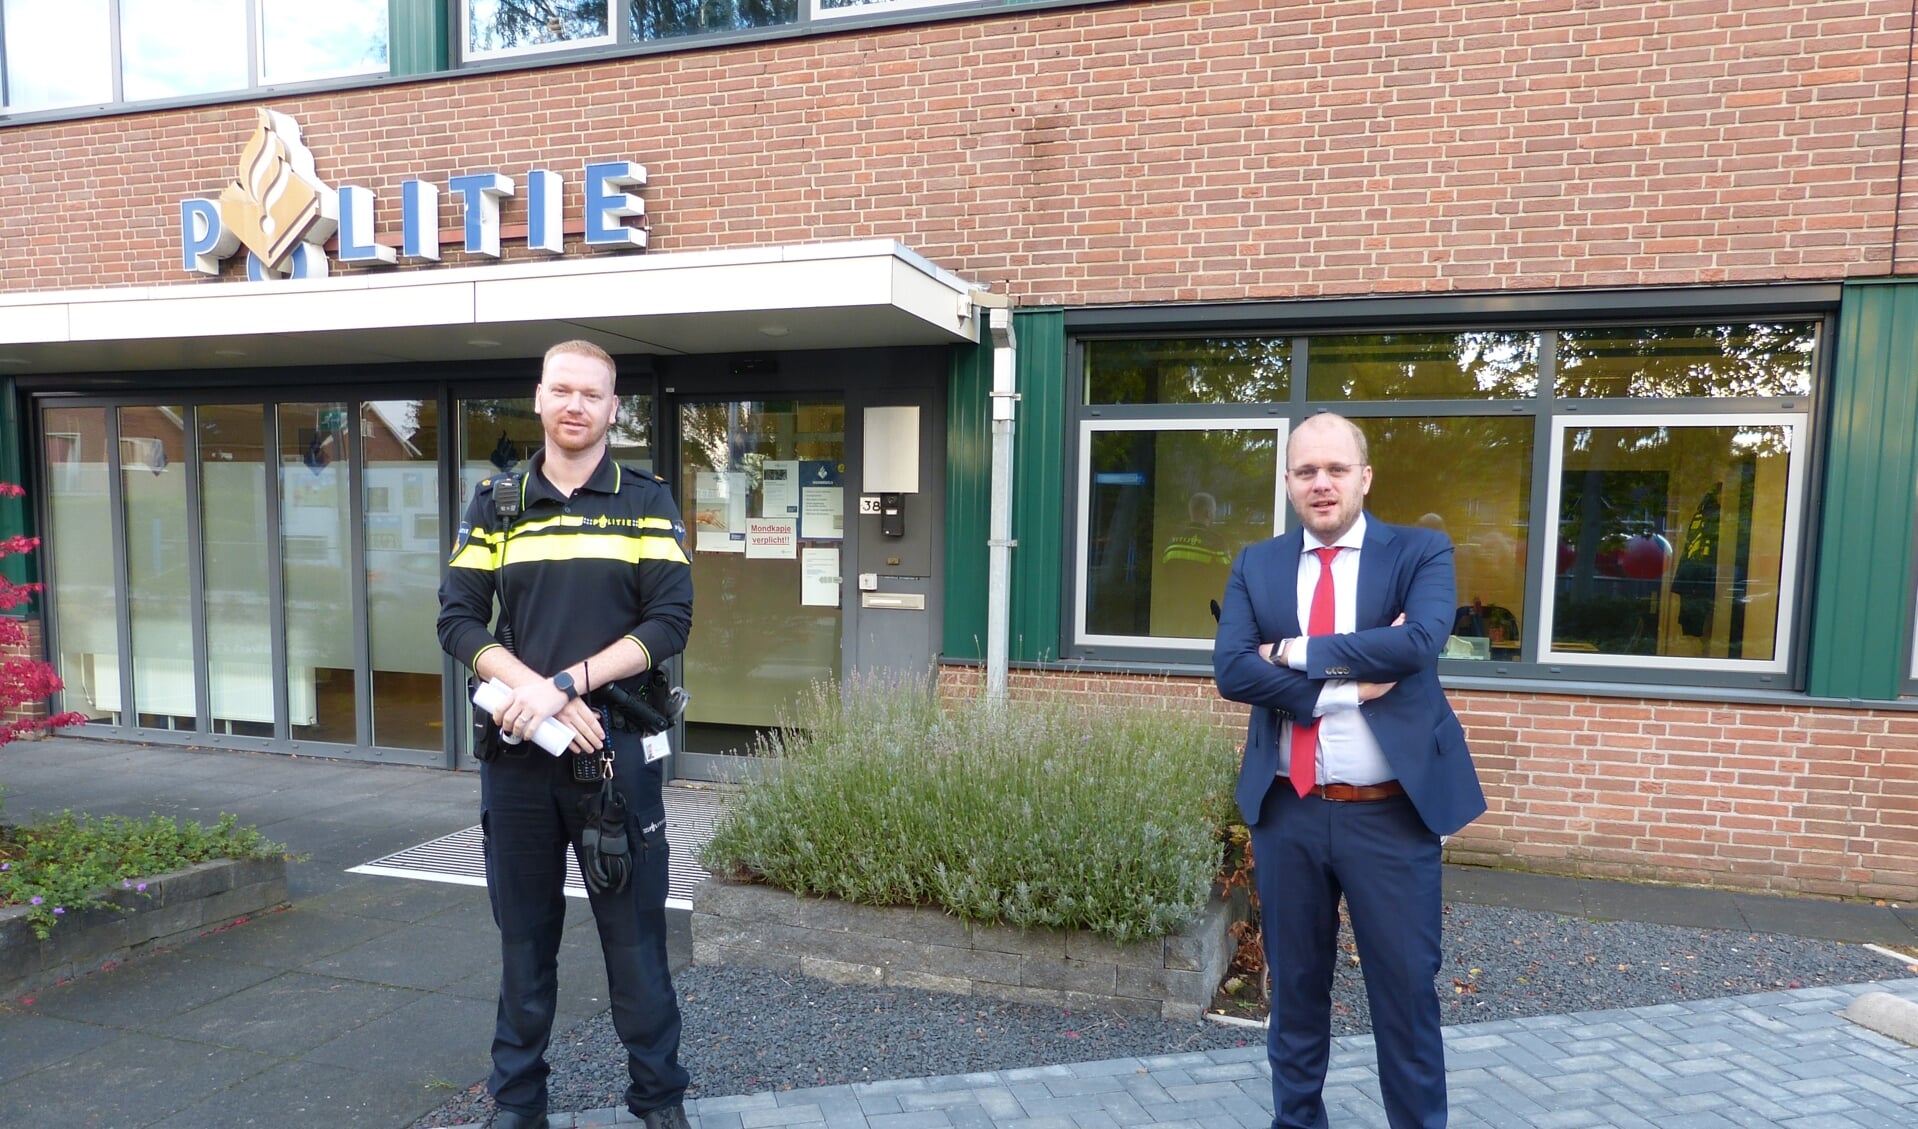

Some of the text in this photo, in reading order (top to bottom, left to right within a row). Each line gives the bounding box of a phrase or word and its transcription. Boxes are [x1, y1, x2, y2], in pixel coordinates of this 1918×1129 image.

[862, 500, 881, 511] 38
[751, 524, 791, 534] Mondkapje
[752, 536, 790, 545] verplicht!!
